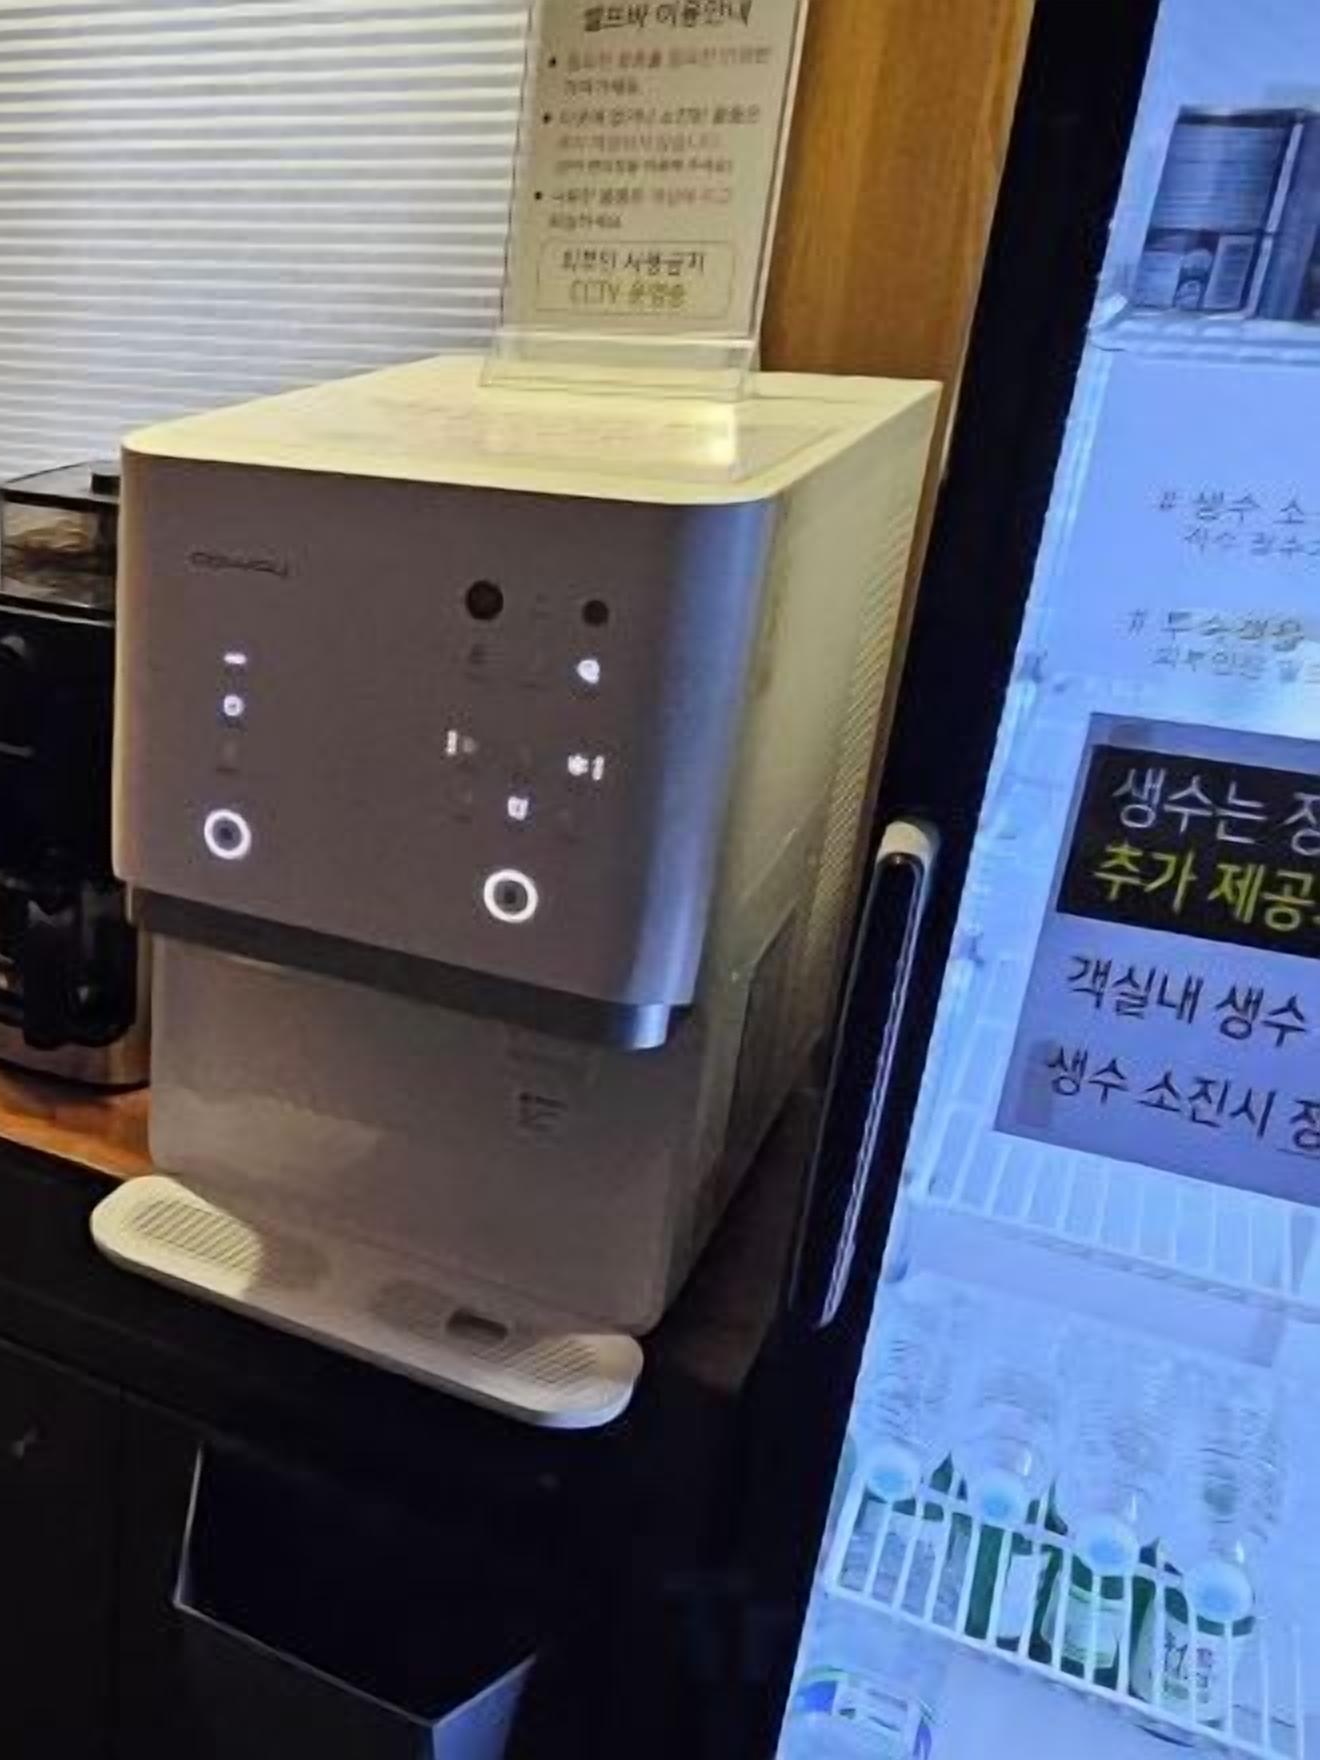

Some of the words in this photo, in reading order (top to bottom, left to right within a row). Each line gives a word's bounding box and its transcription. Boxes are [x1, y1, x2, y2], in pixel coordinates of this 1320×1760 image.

[1112, 768, 1268, 845] 생수는
[1093, 842, 1198, 914] 추가
[1208, 863, 1320, 933] 제공
[1066, 955, 1204, 1025] 객실내
[1214, 984, 1307, 1048] 생수
[1047, 1046, 1129, 1105] 생수
[1137, 1071, 1277, 1138] 소진시
